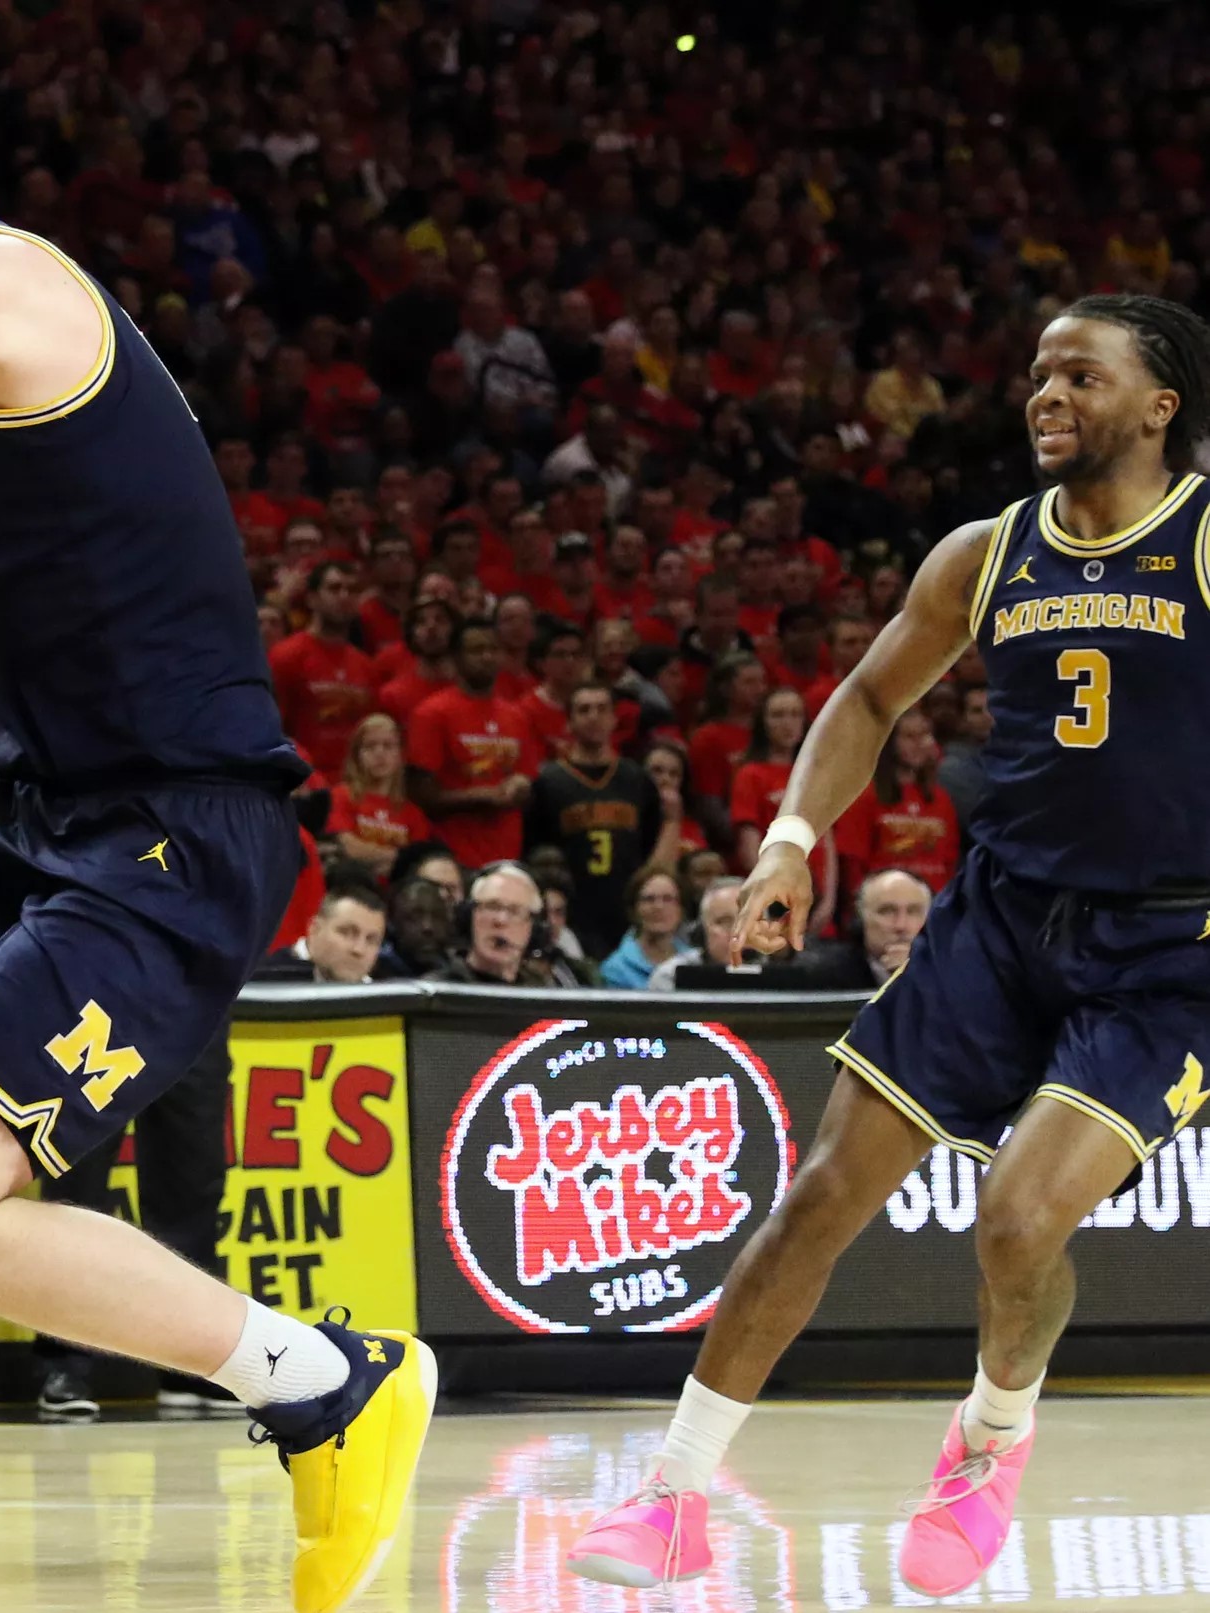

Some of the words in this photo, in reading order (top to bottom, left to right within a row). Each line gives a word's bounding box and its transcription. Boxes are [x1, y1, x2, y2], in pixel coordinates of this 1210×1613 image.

[993, 593, 1186, 647] MICHIGAN
[1054, 648, 1111, 749] 3
[587, 830, 613, 875] 3
[43, 998, 147, 1113] M
[486, 1073, 744, 1190] Jersey
[590, 1264, 688, 1316] SUBS
